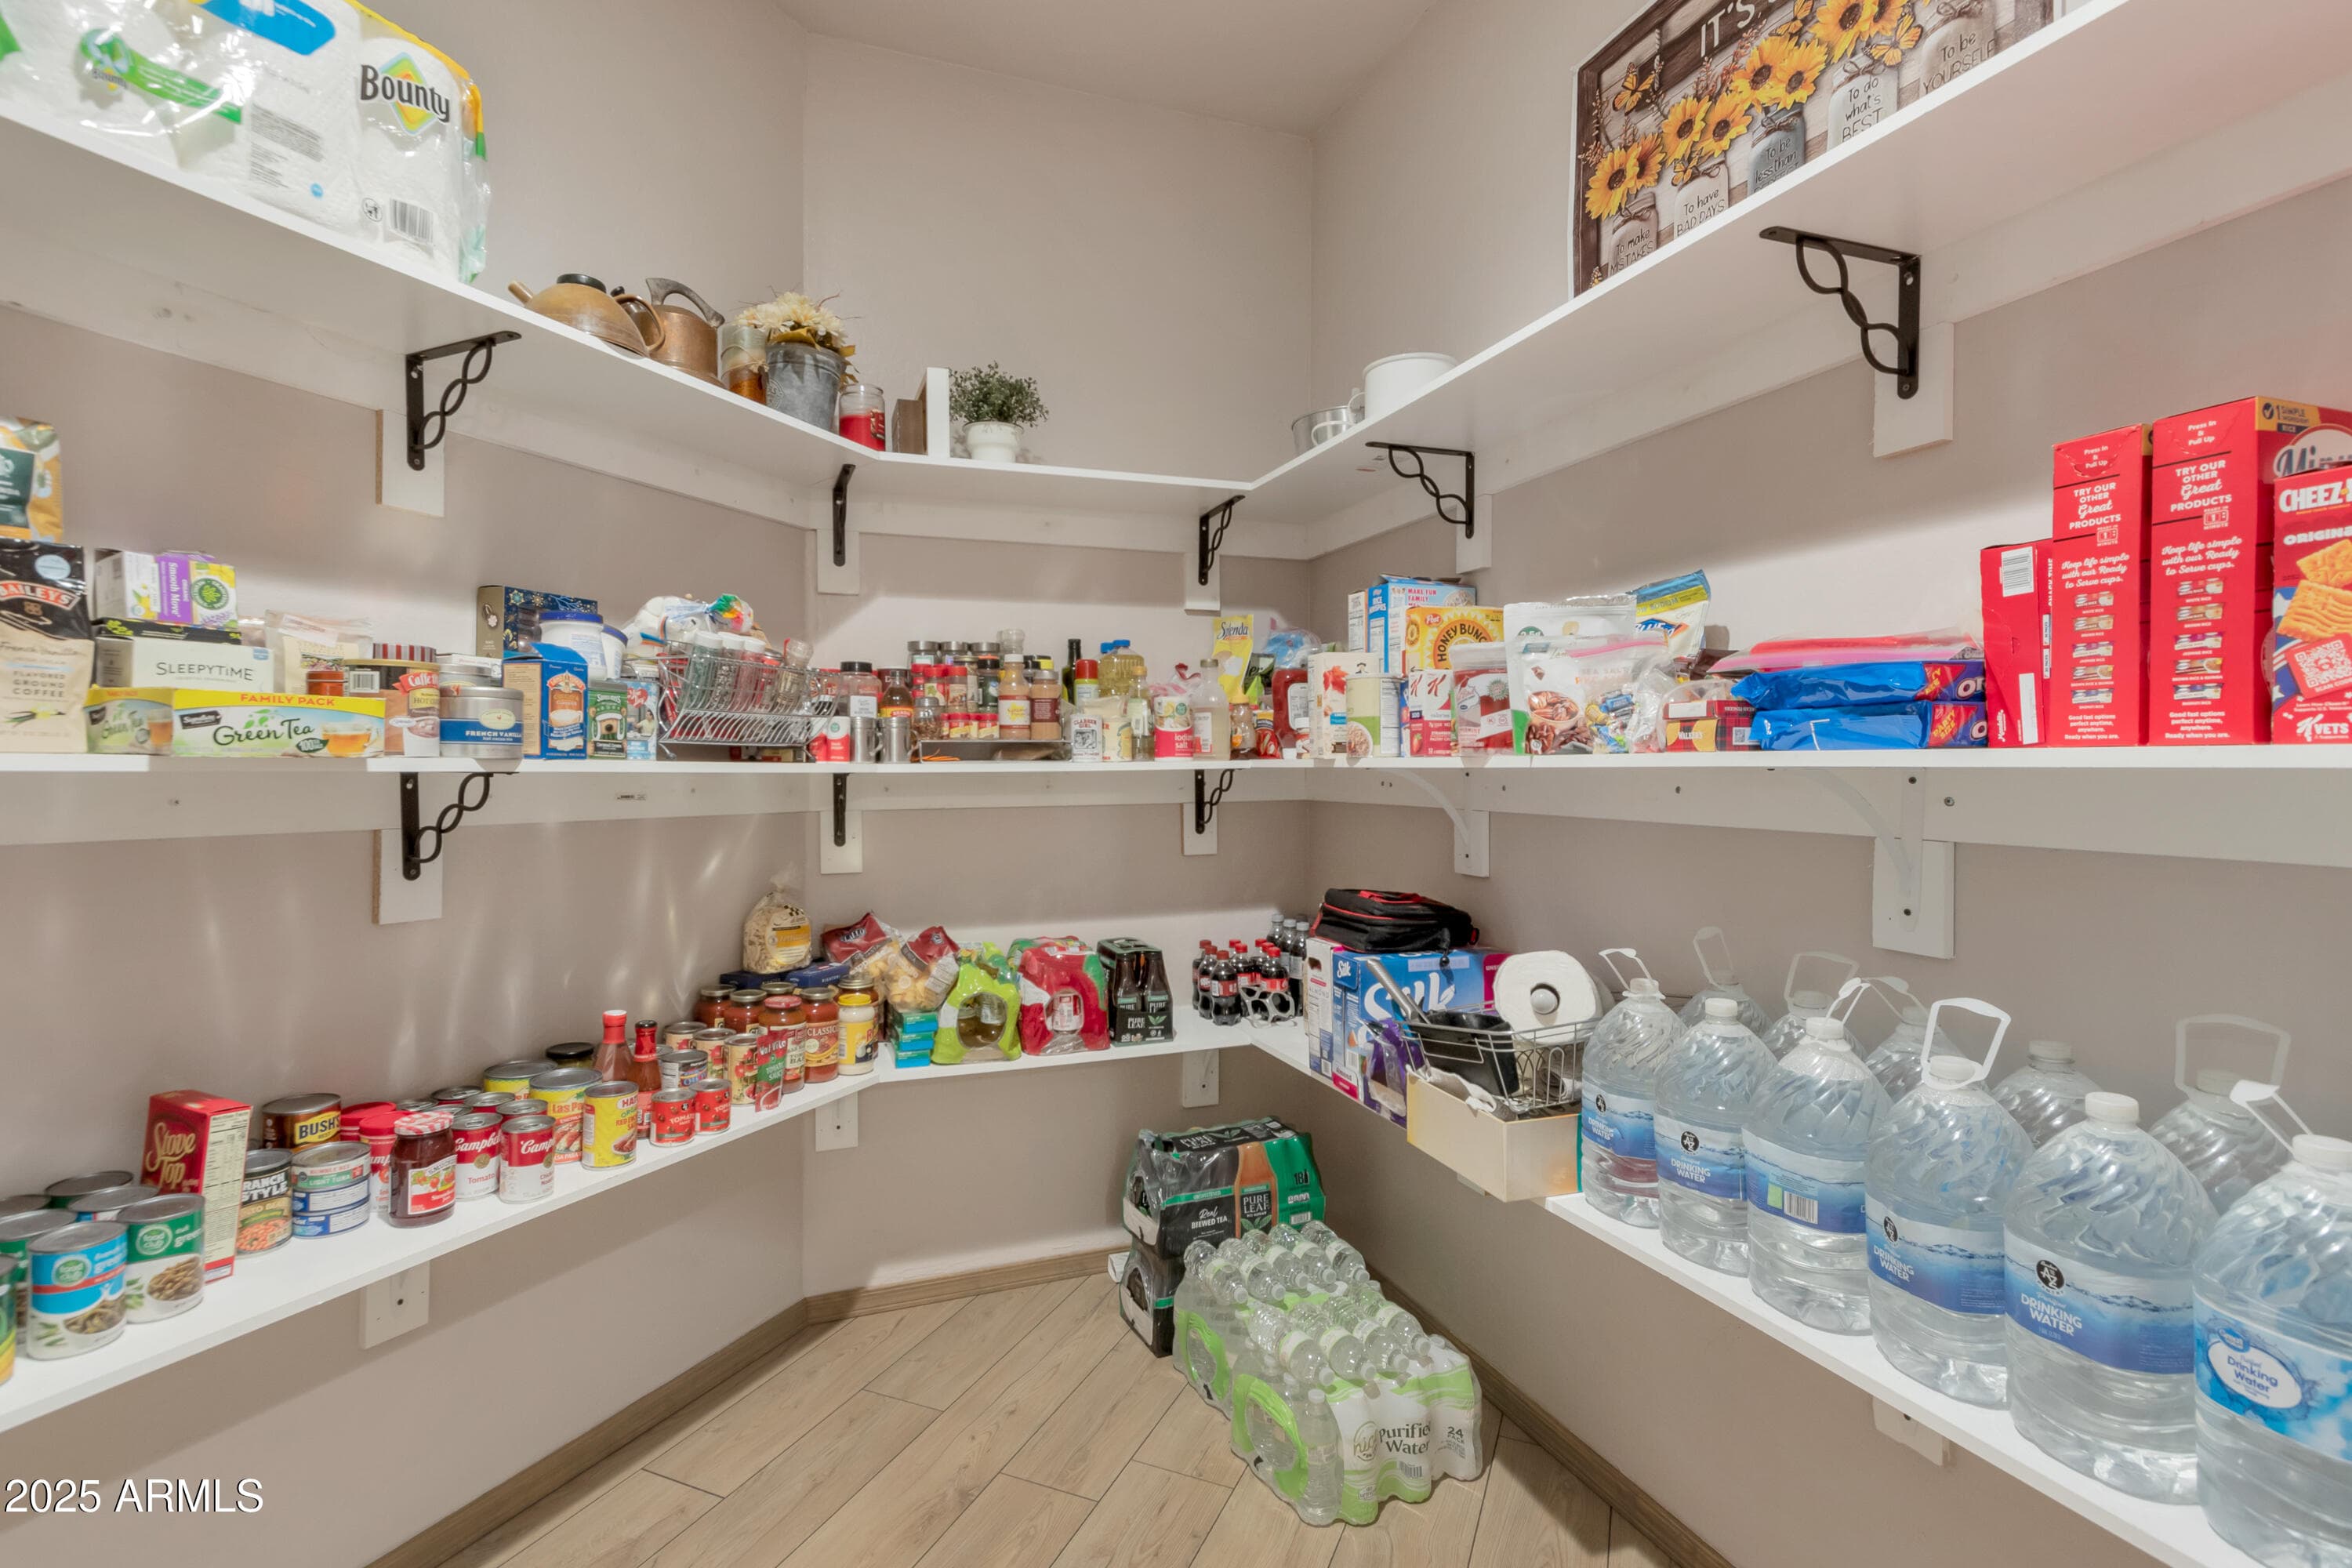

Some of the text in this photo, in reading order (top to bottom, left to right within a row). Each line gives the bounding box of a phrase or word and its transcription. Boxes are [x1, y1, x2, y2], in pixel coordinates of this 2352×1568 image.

[1700, 0, 1755, 59] IT'S
[1941, 32, 1976, 62] To be
[360, 64, 450, 123] Bounty
[1848, 75, 1879, 103] To do
[1845, 94, 1882, 122] what's
[1766, 138, 1791, 160] To be
[1774, 151, 1796, 172] than
[1683, 189, 1719, 216] To have
[1676, 198, 1726, 238] BAD DAYS
[1617, 229, 1650, 255] To make
[2176, 460, 2226, 477] TRY OUR
[2183, 470, 2218, 484] OTHER
[2074, 482, 2116, 497] TRY OUR
[2079, 492, 2109, 503] OTHER
[2181, 478, 2223, 500] Great
[2078, 500, 2113, 519] Great
[2170, 494, 2232, 512] PRODUCTS
[2069, 514, 2122, 530] PRODUCTS
[2284, 526, 2352, 545] ORIGINA
[2161, 537, 2242, 557] Keep life simple
[2061, 553, 2130, 570] Keep life simple
[2161, 556, 2183, 566] with
[2205, 550, 2239, 562] Ready
[2062, 564, 2127, 579] with our Ready
[2179, 564, 2206, 575] Serve
[2208, 562, 2234, 574] cups.
[169, 562, 180, 615] Smooth Move
[2076, 578, 2098, 588] Serve
[2100, 576, 2123, 587] cups.
[1427, 614, 1439, 624] Post
[1217, 622, 1249, 640] Splenda
[1437, 623, 1487, 662] HONEY BUNC
[13, 670, 66, 680] FLAVORED
[13, 680, 65, 688] GROUND
[13, 688, 64, 697] COFFEE
[1428, 674, 1446, 697] K
[241, 694, 335, 706] FAMILY PACK
[213, 718, 315, 746] Green Tea
[1933, 710, 1955, 737] PARTY
[1940, 720, 1955, 739] SIZE
[2314, 723, 2349, 735] VETS
[1337, 960, 1351, 978] Silk
[1363, 972, 1456, 1021] Silk
[552, 1104, 570, 1113] Las
[1588, 1116, 1615, 1138] DRINKING
[1592, 1127, 1612, 1142] WATER
[145, 1122, 196, 1171] Stove
[160, 1156, 186, 1190] Top
[1671, 1158, 1711, 1177] DRINKING
[1676, 1167, 1706, 1184] WATER
[243, 1172, 285, 1191] RANCH
[467, 1172, 495, 1185] Tomato
[1294, 1172, 1305, 1185] 18
[242, 1181, 288, 1201] STYLE
[1243, 1193, 1269, 1205] PURE
[1199, 1206, 1218, 1218] Real
[1244, 1203, 1269, 1214] LEAF
[1191, 1215, 1228, 1229] BREWED TEA
[1874, 1245, 1915, 1276] DRINKING
[1879, 1258, 1910, 1283] WATER
[2021, 1293, 2082, 1329] DRINKING
[2030, 1308, 2074, 1337] WATER
[2227, 1355, 2278, 1388] Drinking
[2234, 1370, 2270, 1393] Water
[1447, 1426, 1464, 1439] 24
[1447, 1434, 1465, 1444] PACK
